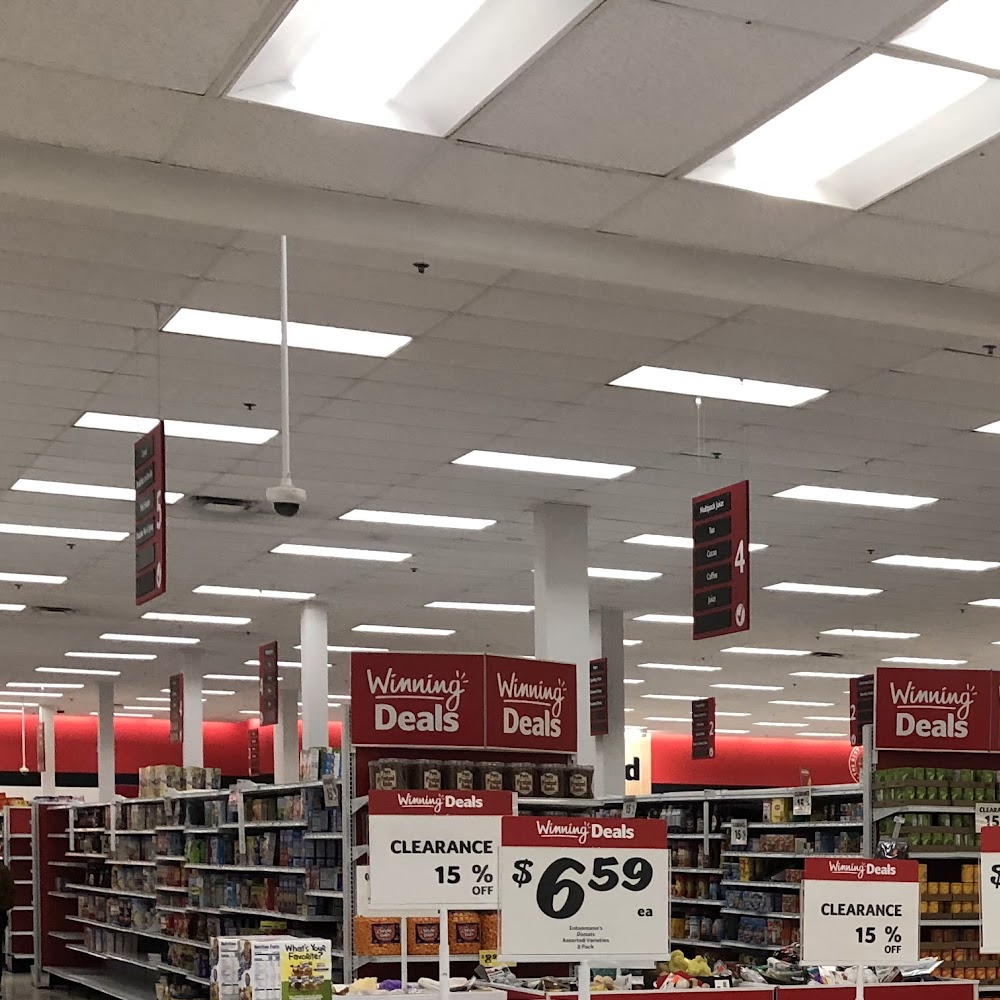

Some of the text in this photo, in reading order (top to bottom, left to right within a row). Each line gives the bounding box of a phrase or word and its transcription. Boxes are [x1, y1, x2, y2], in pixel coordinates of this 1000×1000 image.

[734, 539, 746, 574] 4
[706, 572, 718, 581] Coffee
[367, 667, 469, 711] Winning
[497, 672, 567, 718] Winning
[890, 680, 976, 721] Winning
[374, 703, 460, 733] Deals
[850, 704, 856, 721] 2
[503, 707, 562, 738] Deals
[709, 721, 714, 736] 2
[896, 712, 969, 738] Deals
[397, 793, 484, 814] Winning Deals
[984, 815, 999, 826] 15
[536, 820, 635, 844] Winning Deals
[390, 839, 494, 854] CLEARANCE
[434, 864, 494, 884] 15 %
[829, 860, 896, 878] Winning Deals
[472, 886, 494, 896] OFF
[637, 906, 653, 918] ea
[820, 903, 903, 918] CLEARANCE
[855, 926, 902, 943] 15 %
[285, 944, 310, 952] What's
[884, 945, 902, 954] OFF
